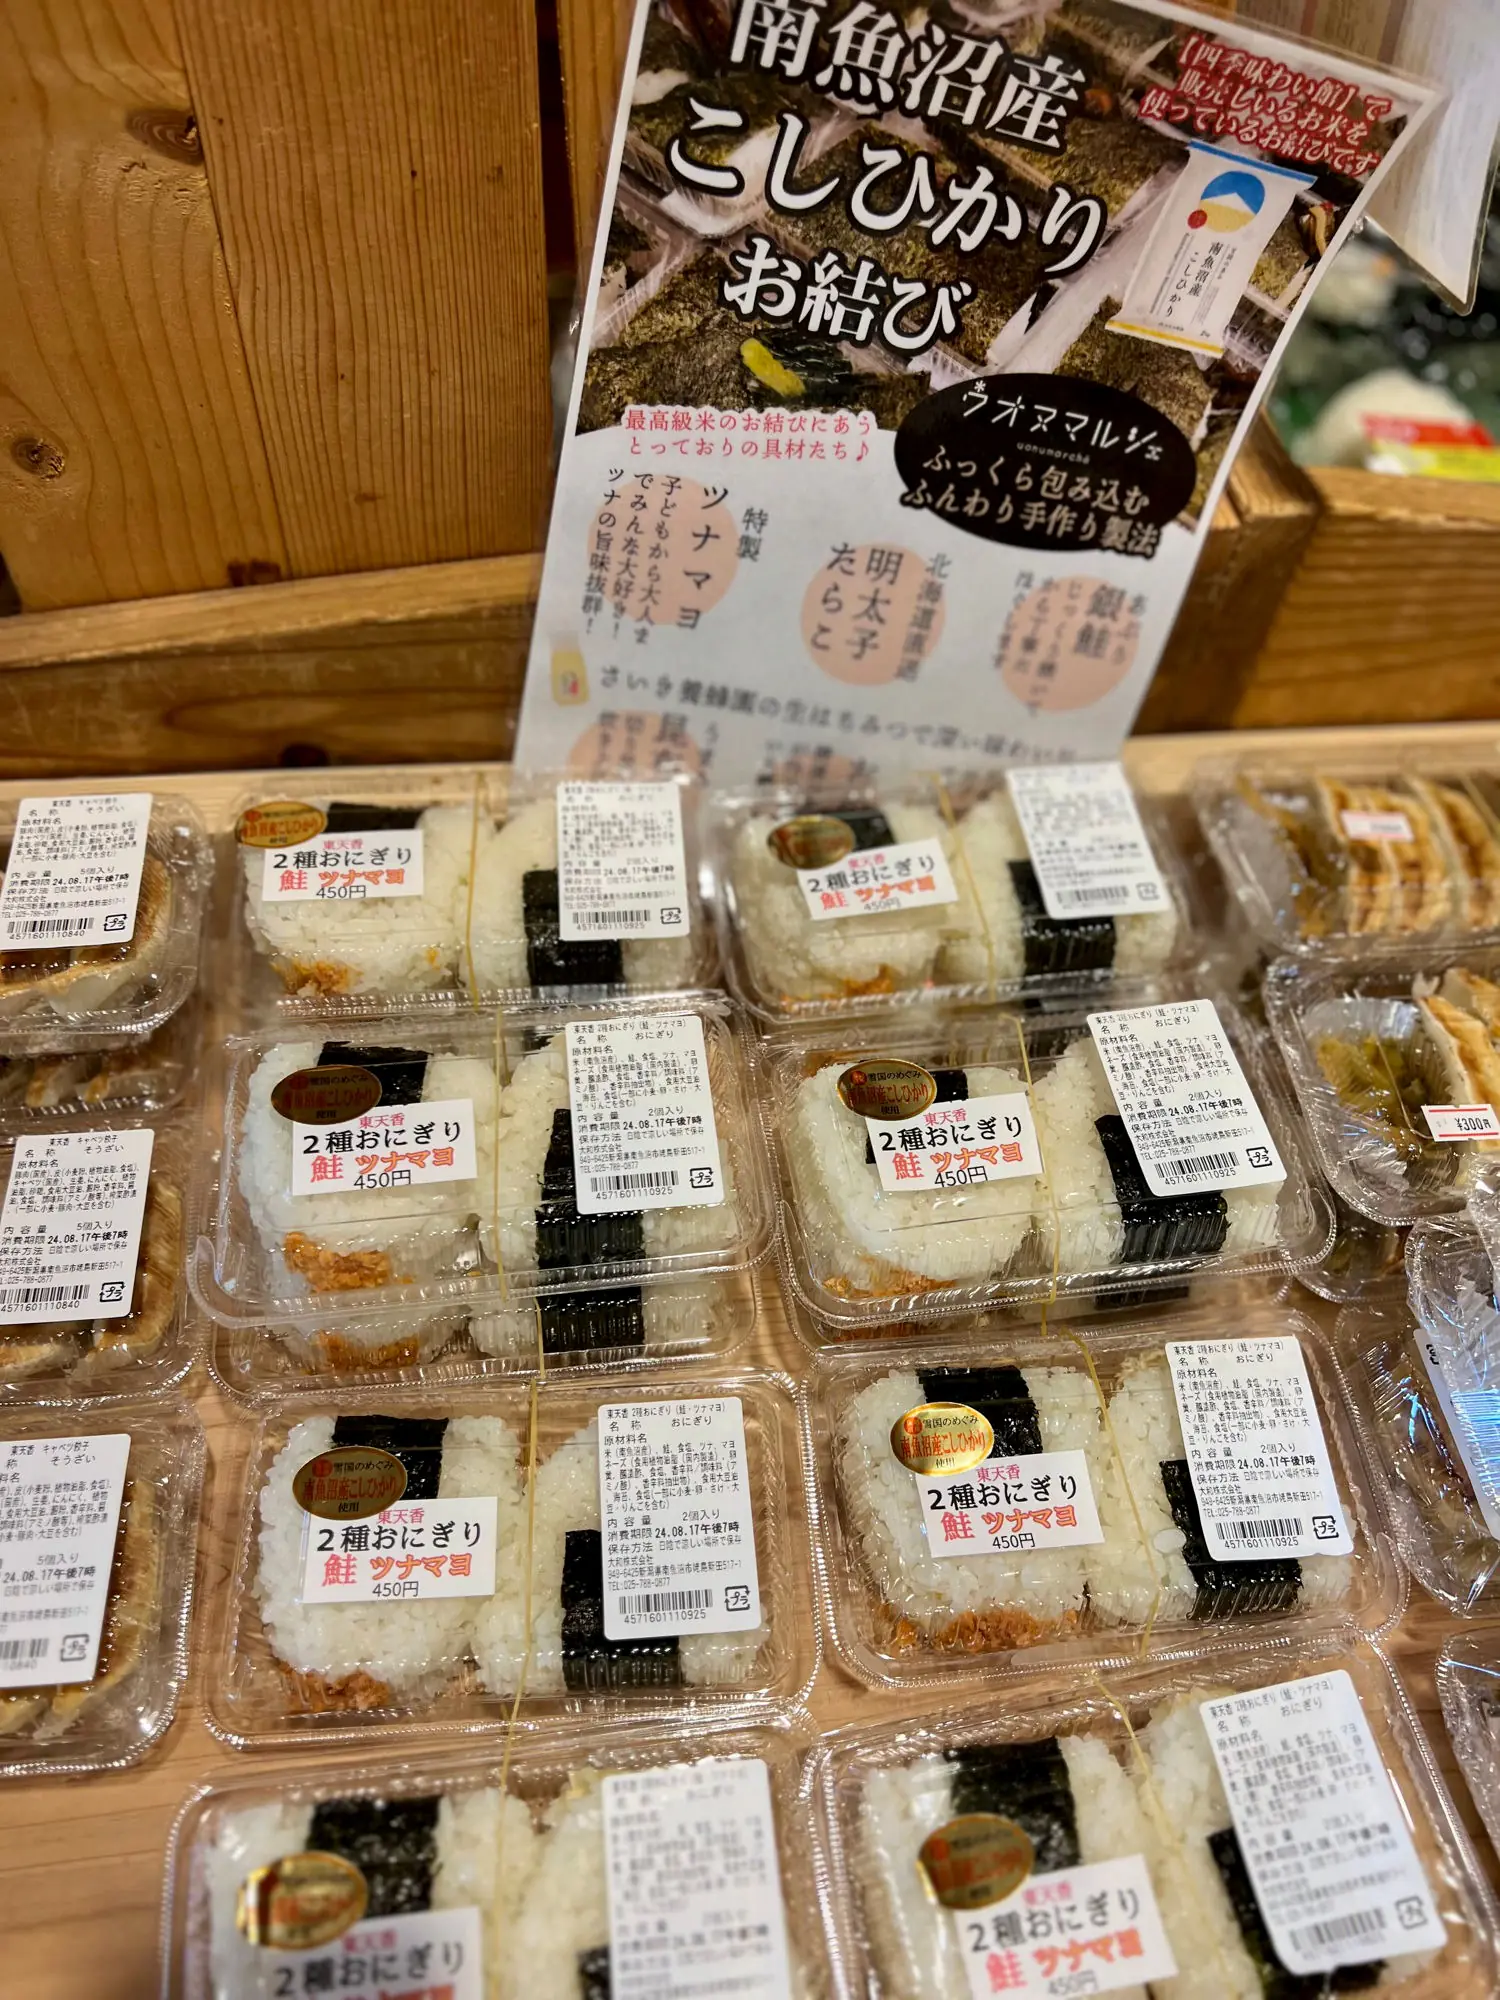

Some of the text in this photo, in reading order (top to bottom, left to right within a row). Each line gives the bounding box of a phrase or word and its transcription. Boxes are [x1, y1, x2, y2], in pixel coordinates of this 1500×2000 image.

[730, 0, 1086, 149] 南魚沼産
[670, 97, 1104, 273] こしひかり
[723, 236, 972, 350] お結び
[1166, 252, 1199, 318] こしひかり
[625, 409, 872, 435] 最高級米のお結びにあう
[922, 444, 1150, 516] ふっくら包み込む
[904, 477, 1161, 556] ふんわり手作り製法
[737, 508, 769, 562] 特製
[676, 486, 729, 630] ツナマヨ
[810, 541, 857, 651] たらこ
[845, 547, 904, 661] 明太子
[322, 839, 364, 850] 東天香
[273, 846, 412, 869] 2種おにぎり
[52, 874, 130, 886] 24.08.17午後7時
[279, 868, 405, 892] 鮭 ツナマヨ
[807, 855, 935, 893] 2種おにぎり
[316, 885, 367, 899] 450円
[9, 931, 85, 940] 4571601110840
[1155, 1016, 1191, 1028] おにぎり
[635, 1031, 675, 1040] おにぎり
[1099, 1034, 1139, 1046] 原材料名
[572, 1045, 613, 1056] 原材料名
[1123, 1089, 1223, 1112] 内容量 2個入り
[577, 1106, 684, 1123] 内容量 2個入り
[923, 1108, 968, 1126] 東天香
[1128, 1098, 1244, 1122] 消費期限 24.08.17午後7時
[359, 1112, 406, 1129] 東天香
[578, 1116, 702, 1133] 消費期限 24.08.17午後7時
[1131, 1119, 1173, 1133] 保存方法
[302, 1121, 461, 1155] 2種おにぎり
[579, 1133, 622, 1144] 保存方法
[878, 1116, 1023, 1151] 2種おにぎり
[84, 1145, 124, 1155] そうざい
[17, 1159, 59, 1169] 原材料名
[310, 1147, 456, 1183] 鮭 ツナマヨ
[892, 1142, 1025, 1180] 鮭 ツナマヨ
[353, 1169, 412, 1190] 450円
[934, 1165, 989, 1188] 450円
[1164, 1168, 1237, 1185] 4571601110925
[595, 1187, 673, 1200] 4571601110925
[4, 1220, 113, 1235] 内容量 5個入り
[1, 1230, 129, 1245] 消費期限 24.08.17午後7時
[0, 1301, 80, 1313] 4571601110840
[1236, 1353, 1274, 1364] おにぎり
[1176, 1369, 1218, 1380] 原材料名
[671, 1416, 712, 1428] おにぎり
[922, 1415, 979, 1429] 雪国のめぐみ
[604, 1433, 648, 1446] 原材料名
[899, 1429, 986, 1460] 南魚沼産こしひかり
[1191, 1442, 1296, 1459] 内容量 2個入り
[51, 1454, 96, 1467] そうざい
[1194, 1455, 1316, 1472] 消費期限 24.08.17午後7時
[975, 1463, 1021, 1482] 東天香
[1196, 1474, 1240, 1484] 保存方法
[303, 1475, 398, 1501] 南魚沼産こしひかり
[926, 1474, 1077, 1511] 2種おにぎり
[337, 1502, 360, 1513] 使用
[377, 1507, 425, 1525] 東天香
[607, 1509, 721, 1528] 内容量 2個入り
[940, 1504, 1078, 1542] 鮭 ツナマヨ
[316, 1520, 481, 1553] 2種おにぎり
[608, 1521, 740, 1542] 消費期限 24.08.17午後7時
[608, 1542, 653, 1555] 保存方法
[992, 1532, 1036, 1550] 450円
[1224, 1537, 1299, 1549] 4571601110925
[37, 1552, 80, 1566] 5個入り
[3, 1566, 97, 1584] 24.08.17午後7時
[321, 1552, 473, 1587] 鮭 ツナマヨ
[372, 1581, 419, 1598] 450円
[624, 1609, 706, 1624] 4571601110925
[1281, 1697, 1324, 1718] おにぎり
[967, 1888, 1140, 1953] 2種おにぎり
[986, 1948, 1028, 1993] 鮭
